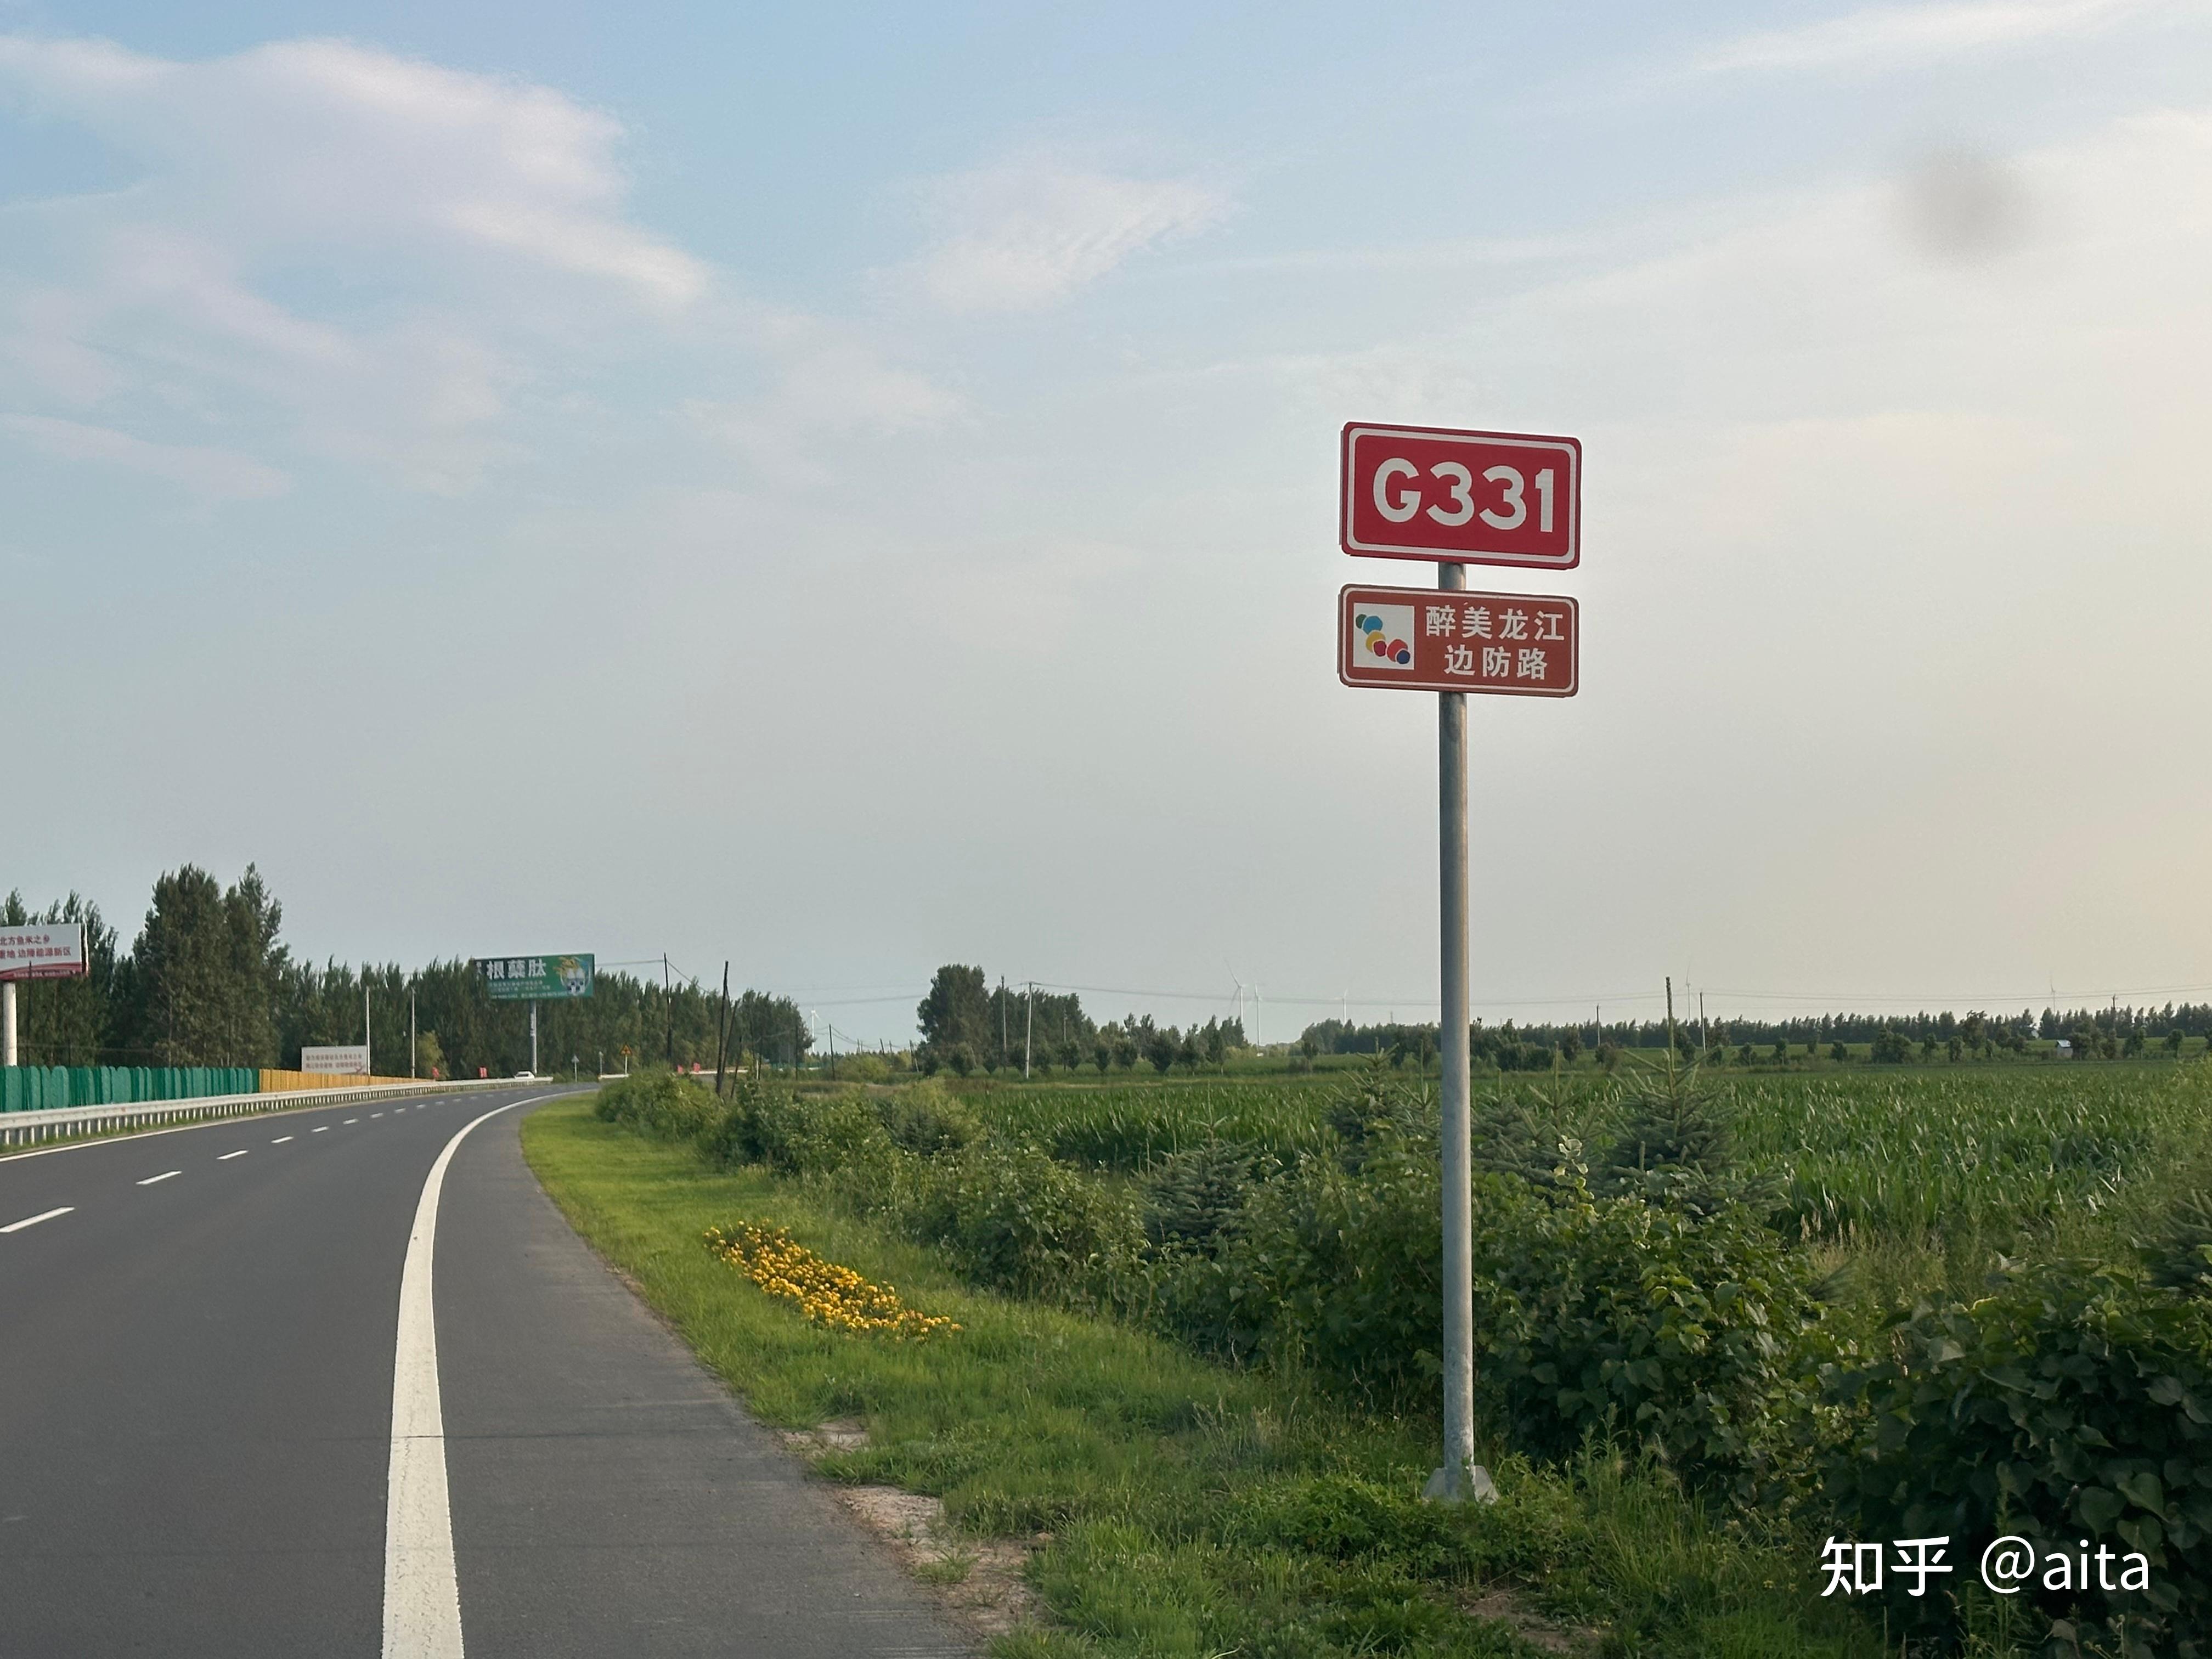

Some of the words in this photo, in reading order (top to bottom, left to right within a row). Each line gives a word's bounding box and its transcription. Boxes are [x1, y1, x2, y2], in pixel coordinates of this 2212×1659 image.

[1373, 458, 1554, 533] G331
[1425, 605, 1565, 641] 醉美龙江
[1444, 644, 1548, 680] 边防路
